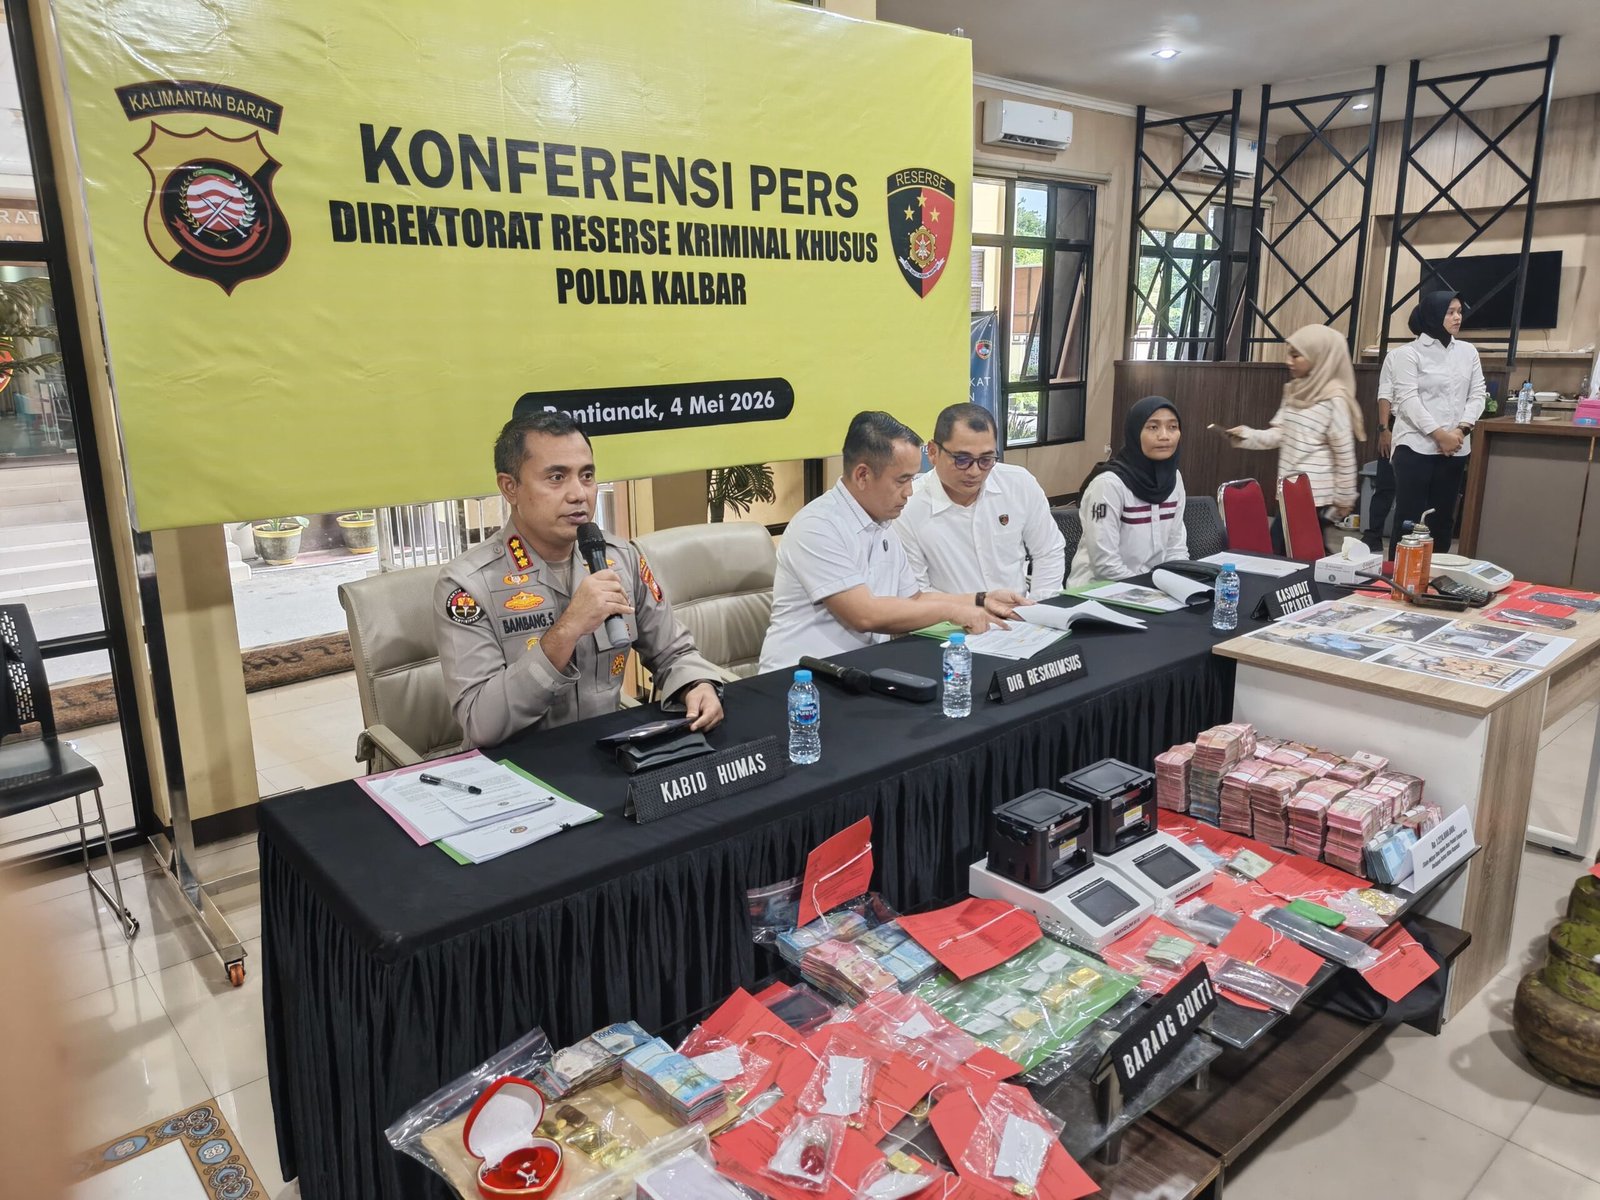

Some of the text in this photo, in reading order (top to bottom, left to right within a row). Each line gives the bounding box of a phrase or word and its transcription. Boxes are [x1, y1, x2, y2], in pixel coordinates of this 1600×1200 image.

[129, 90, 273, 123] KALIMANTAN BARAT
[360, 123, 859, 218] KONFERENSI PERS
[895, 170, 947, 190] RESERSE
[329, 200, 878, 263] DIREKTORAT RESERSE KRIMINAL KHUSUS
[556, 268, 747, 305] POLDA KALBAR
[670, 397, 683, 416] 4
[689, 394, 725, 415] Mei
[730, 391, 776, 411] 2026
[502, 612, 555, 634] BAMBANG.S
[1006, 654, 1082, 692] DIR RESKRIMSUS
[660, 753, 767, 803] KABID HUMAS
[1122, 978, 1213, 1079] BARANG BUKTI
